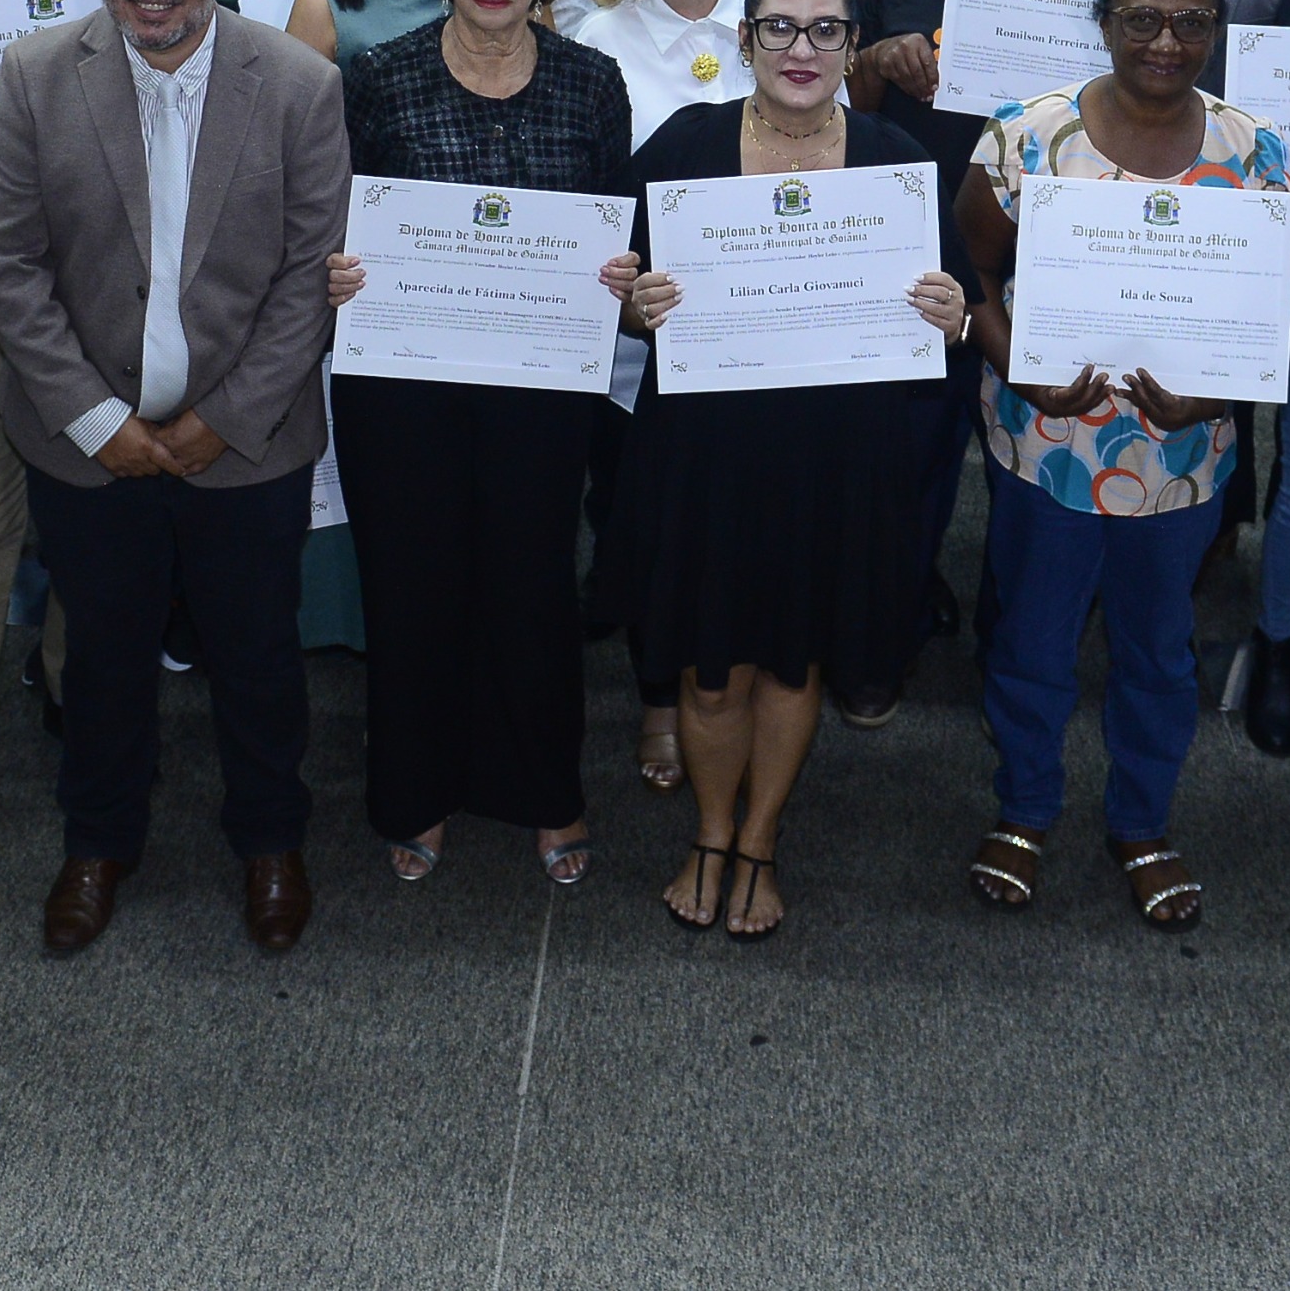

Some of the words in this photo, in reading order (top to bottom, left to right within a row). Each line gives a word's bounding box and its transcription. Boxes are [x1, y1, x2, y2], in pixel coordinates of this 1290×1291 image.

[995, 26, 1045, 43] Romilson
[1048, 34, 1090, 50] Ferreira
[700, 226, 756, 241] Diploma
[759, 224, 774, 236] de
[777, 221, 819, 235] Honra
[822, 220, 837, 230] ao
[840, 214, 885, 230] Mérito
[1071, 224, 1124, 240] Diploma
[1128, 229, 1141, 241] de
[1145, 229, 1185, 244] Honra
[1188, 235, 1202, 245] ao
[1205, 233, 1248, 248] Mérito
[720, 240, 760, 253] Câmara
[762, 236, 813, 251] Municipal
[814, 236, 826, 245] de
[828, 233, 868, 244] Goiânia
[1087, 241, 1126, 254] Câmara
[1127, 244, 1177, 258] Municipal
[1179, 248, 1190, 258] de
[1192, 248, 1230, 261] Goiânia
[394, 280, 454, 295] Aparecida
[457, 285, 472, 296] de
[475, 287, 516, 300] Fátima
[518, 291, 567, 305] Siqueira
[729, 286, 765, 298] Lilian
[768, 282, 800, 295] Carla
[803, 276, 864, 292] Giovanuci
[1120, 288, 1139, 300] Ida
[1141, 290, 1157, 302] de
[1158, 291, 1193, 304] Souza
